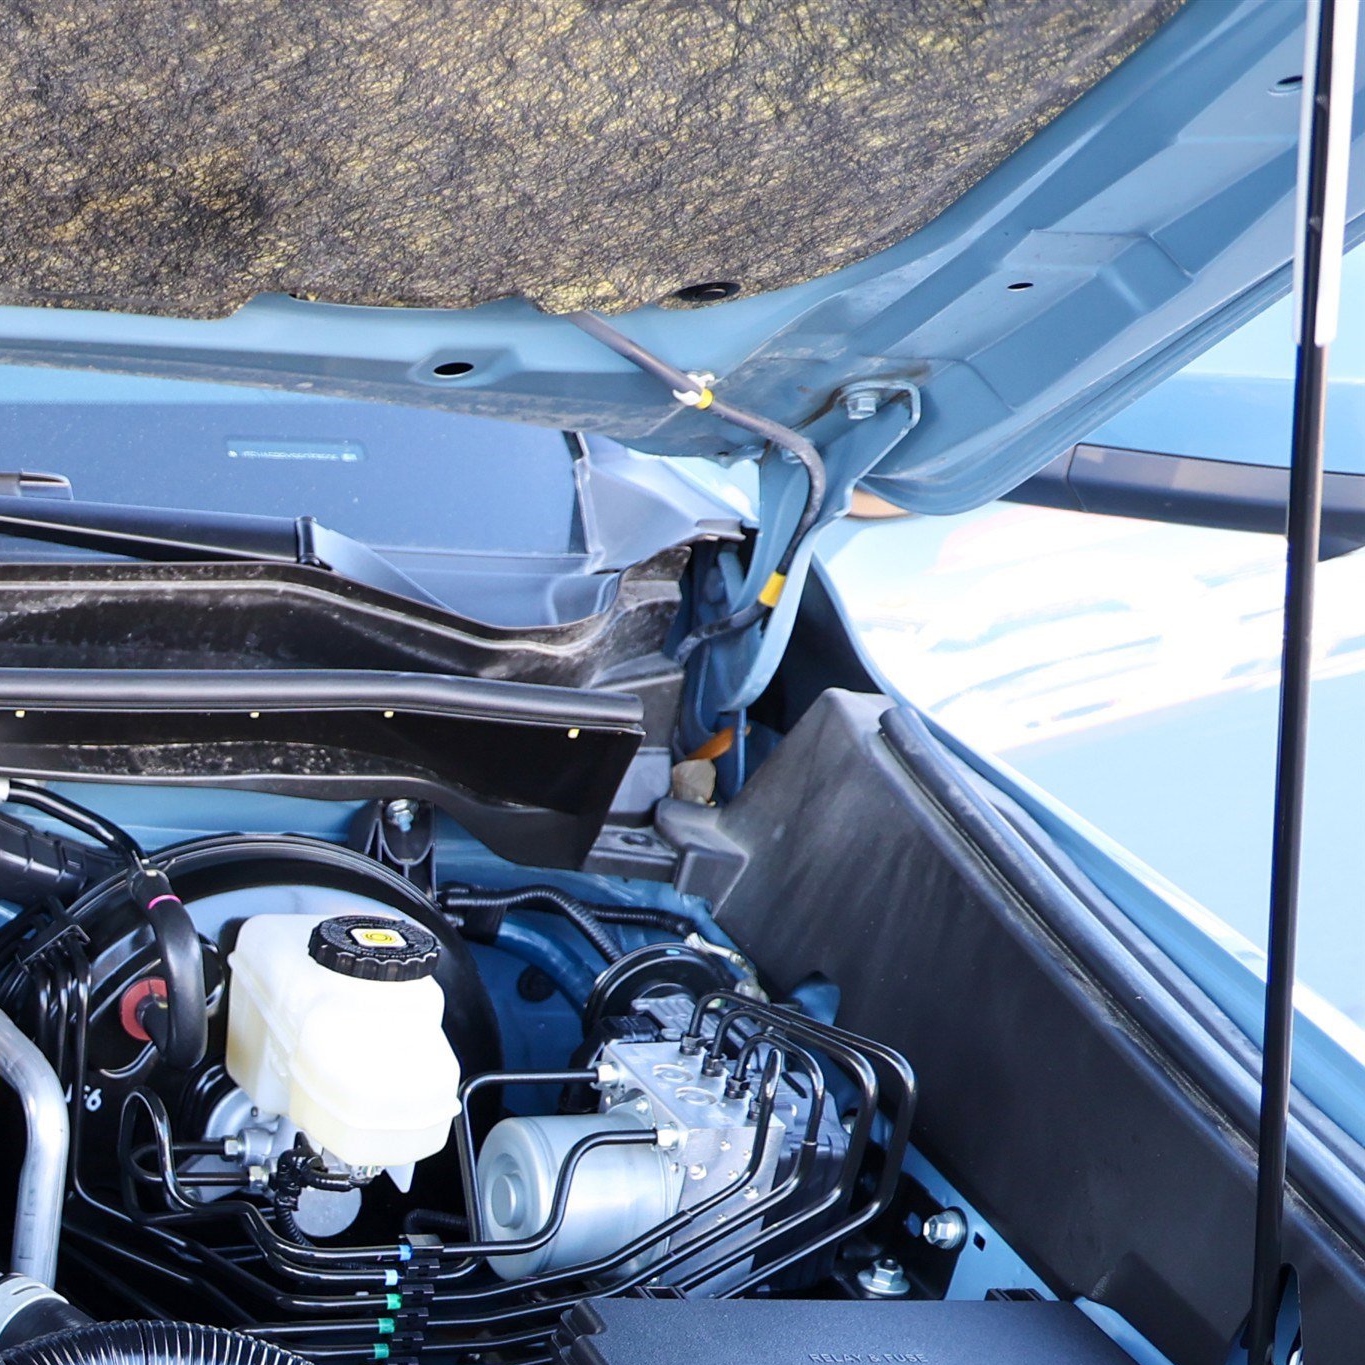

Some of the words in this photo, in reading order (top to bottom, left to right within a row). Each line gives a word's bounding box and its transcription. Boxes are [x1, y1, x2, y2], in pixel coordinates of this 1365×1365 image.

[808, 1353, 862, 1363] RELAY
[867, 1353, 881, 1363] &
[883, 1353, 929, 1363] FUSE
